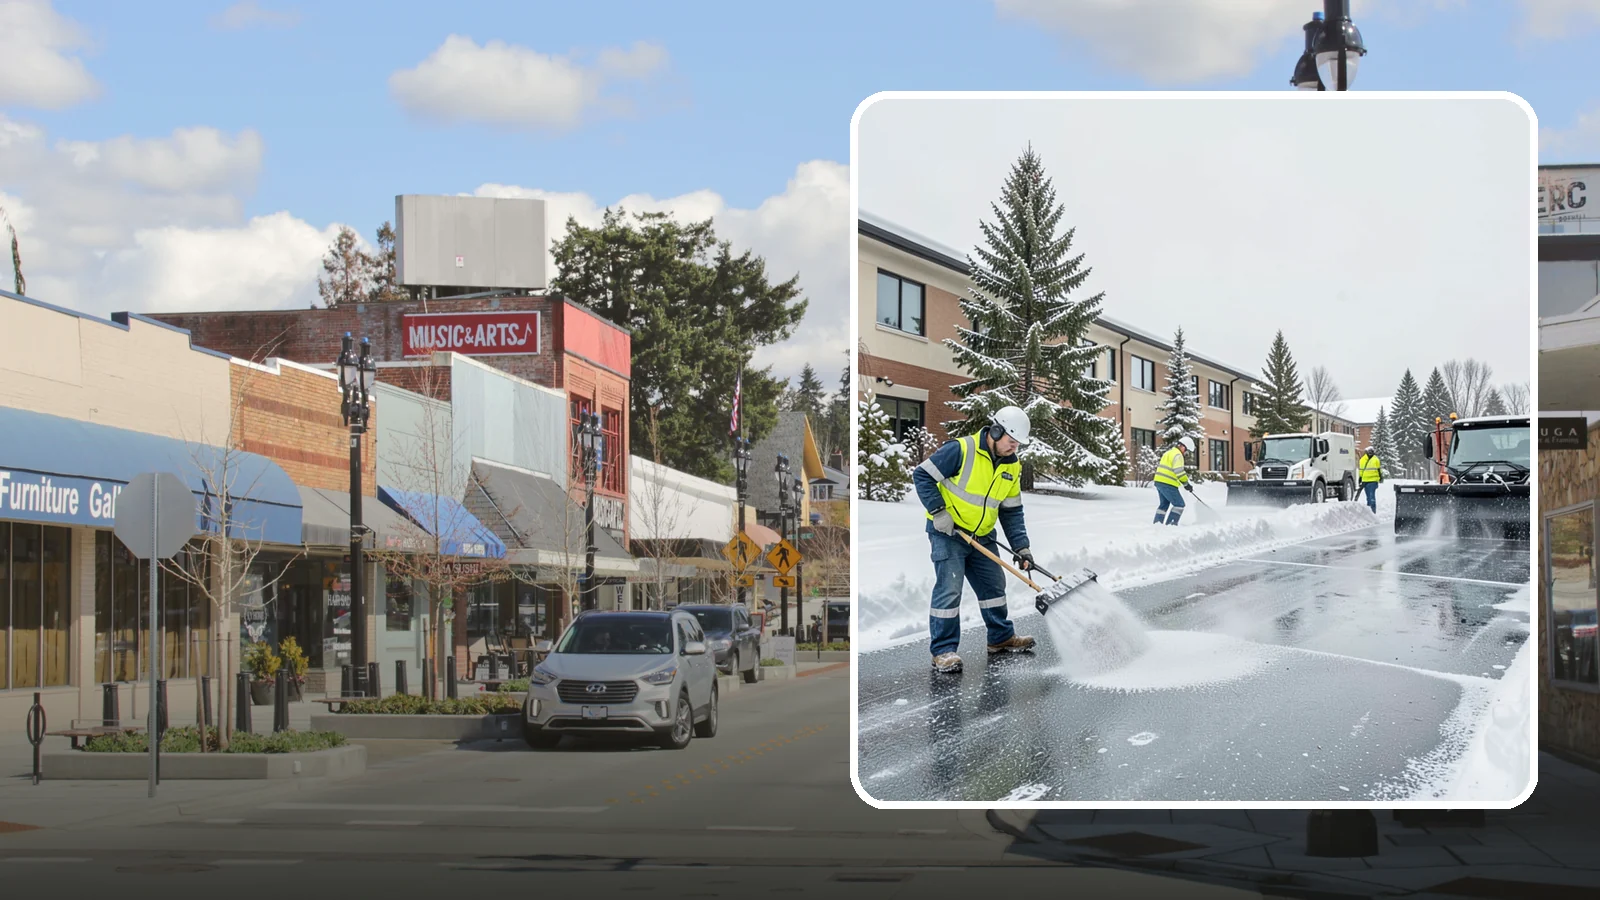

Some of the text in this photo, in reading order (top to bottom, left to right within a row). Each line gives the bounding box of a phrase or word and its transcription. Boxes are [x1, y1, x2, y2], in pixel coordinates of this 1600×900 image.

[409, 323, 519, 348] MUSIC&ARTS
[0, 471, 122, 519] Furniture Gal
